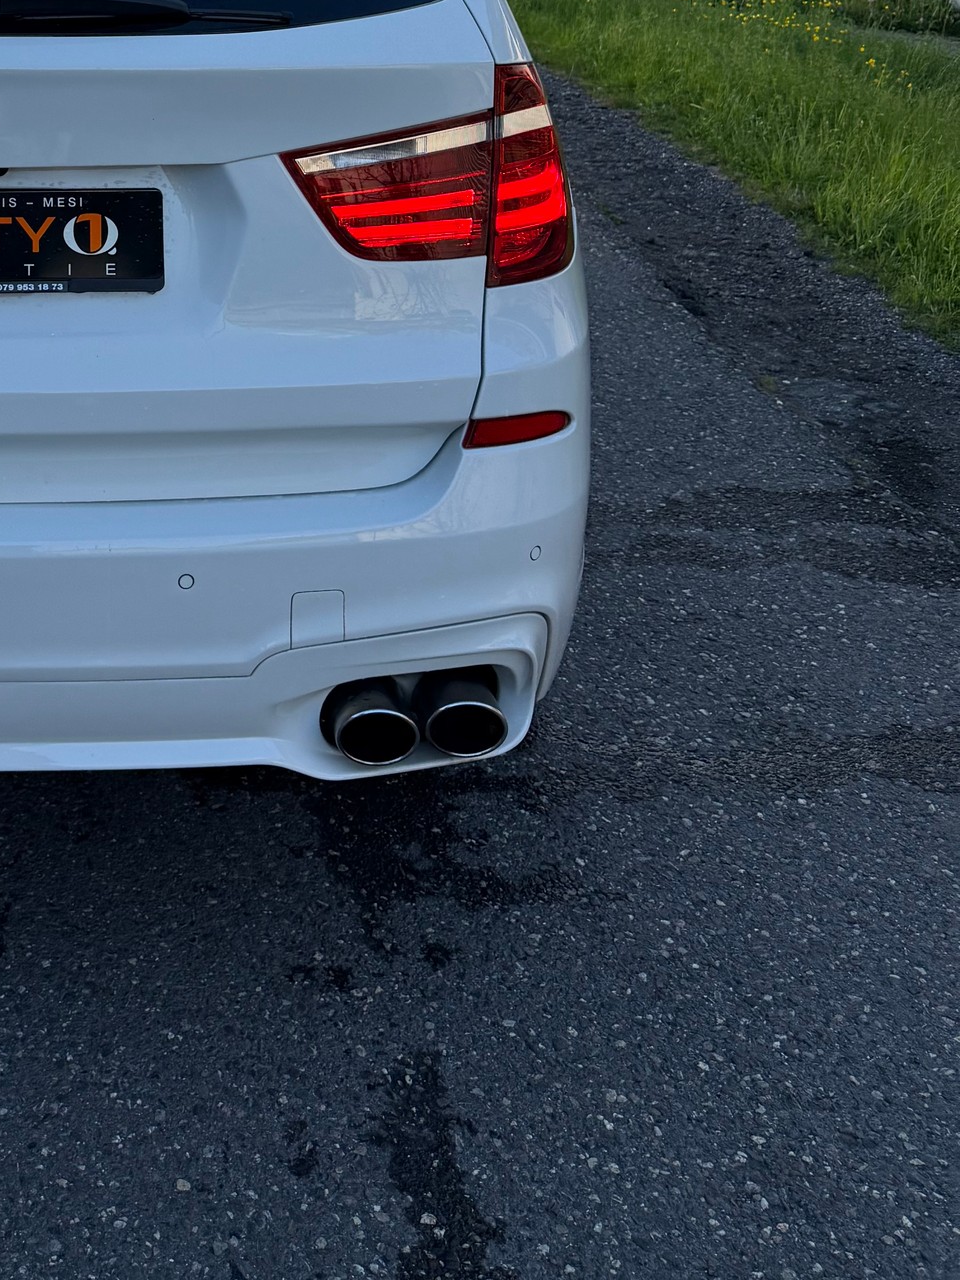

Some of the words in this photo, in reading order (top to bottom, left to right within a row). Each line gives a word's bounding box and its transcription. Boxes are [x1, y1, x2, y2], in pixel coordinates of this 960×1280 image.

[43, 197, 83, 208] MESI
[16, 283, 35, 291] 953
[38, 283, 49, 291] 18
[51, 283, 63, 291] 73
